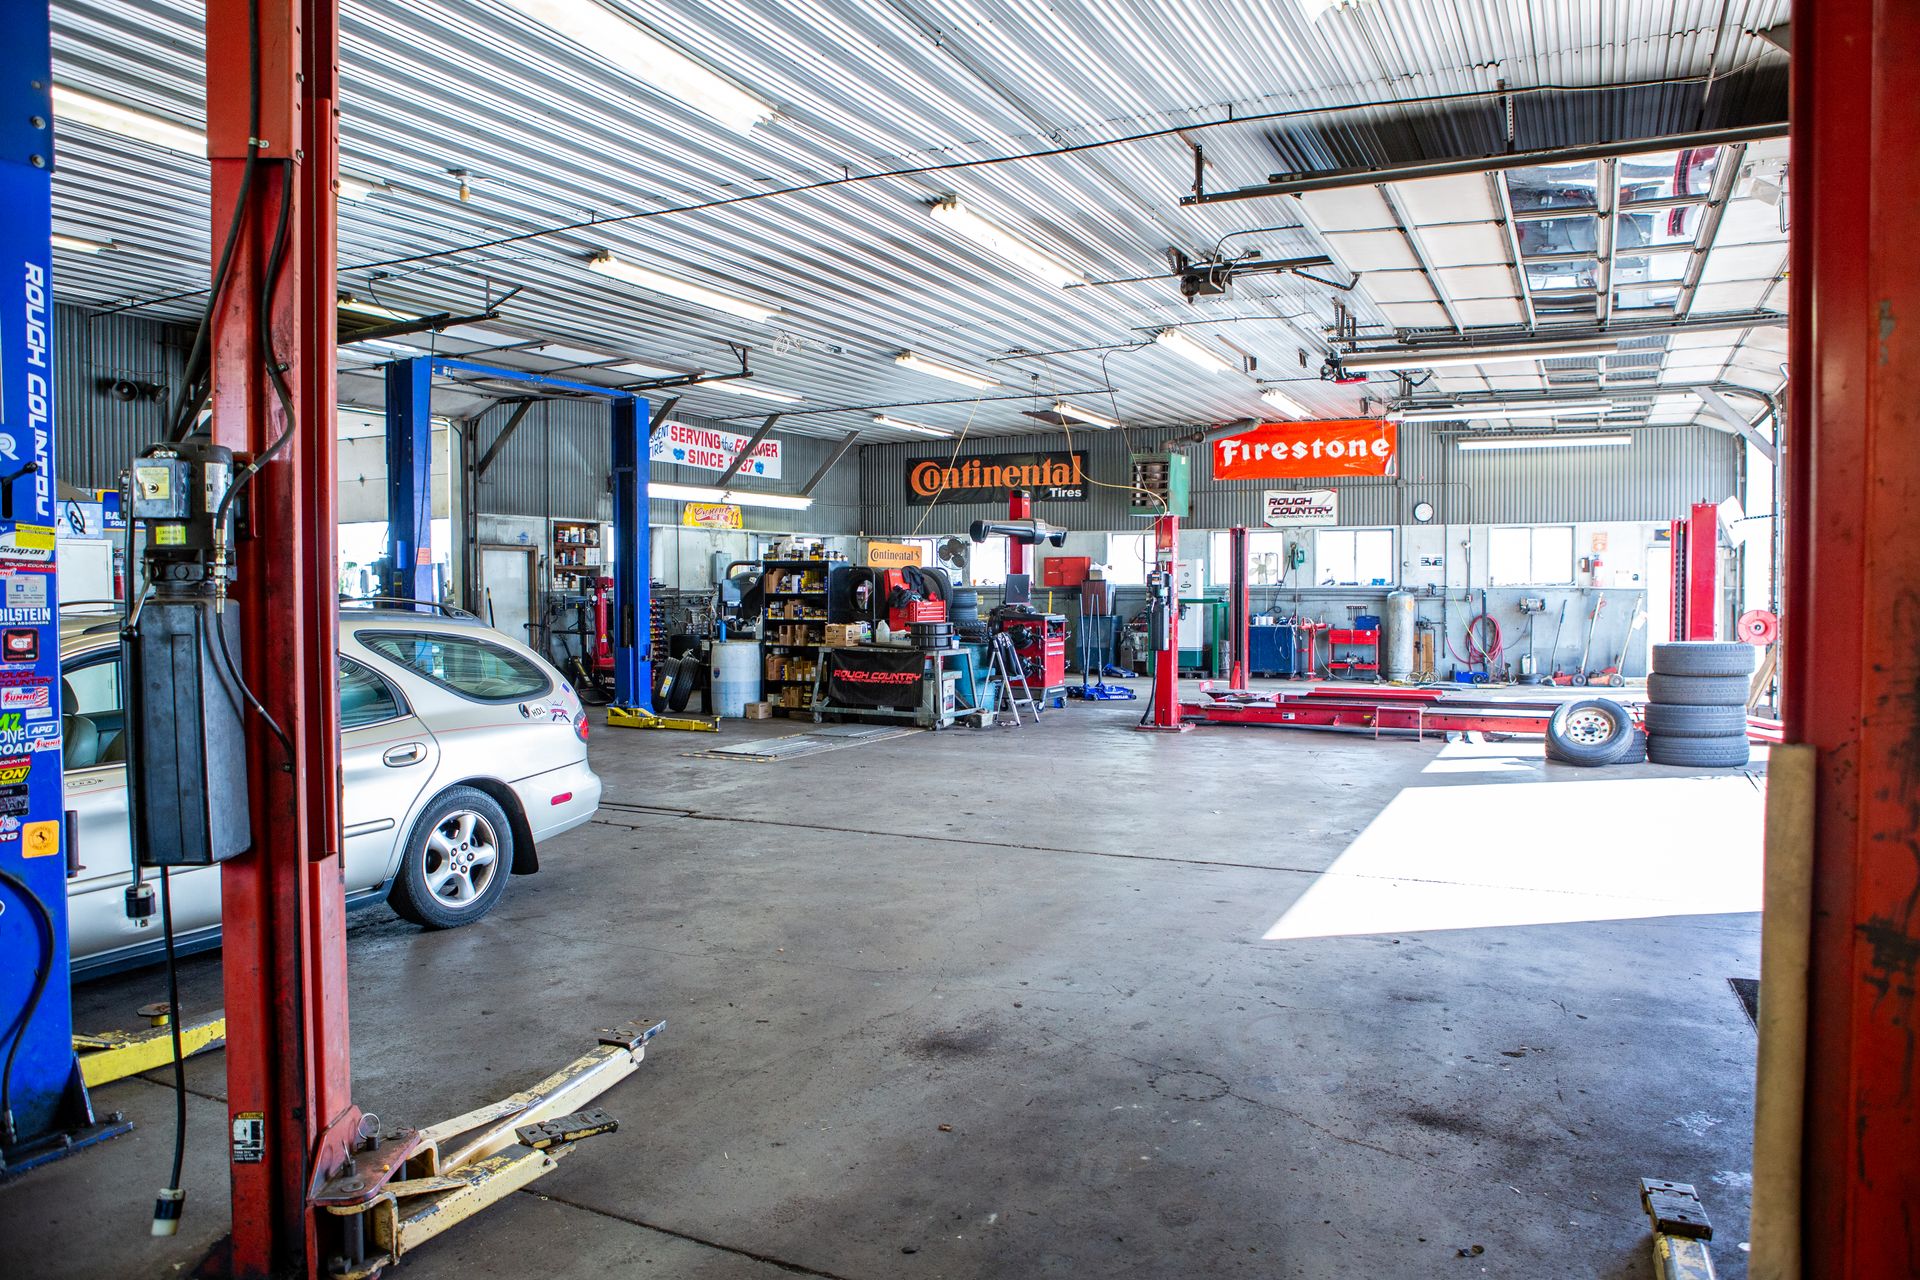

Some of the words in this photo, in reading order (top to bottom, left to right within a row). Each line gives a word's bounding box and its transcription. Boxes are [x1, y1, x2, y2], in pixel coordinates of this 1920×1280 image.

[25, 261, 46, 368] ROUGH
[649, 425, 669, 443] SCENT
[671, 425, 721, 449] SERVING
[721, 435, 734, 452] the
[735, 439, 778, 457] FAMER
[688, 449, 724, 468] SINCE
[728, 456, 755, 472] 137
[1219, 438, 1390, 467] Firestone
[910, 456, 1082, 497] Continental
[1050, 487, 1082, 498] Tires
[1268, 497, 1312, 506] ROUGH
[1271, 506, 1333, 515] COUNTRY
[870, 548, 914, 562] Continental
[833, 669, 869, 679] ROUGH
[871, 672, 921, 681] COUNTRY
